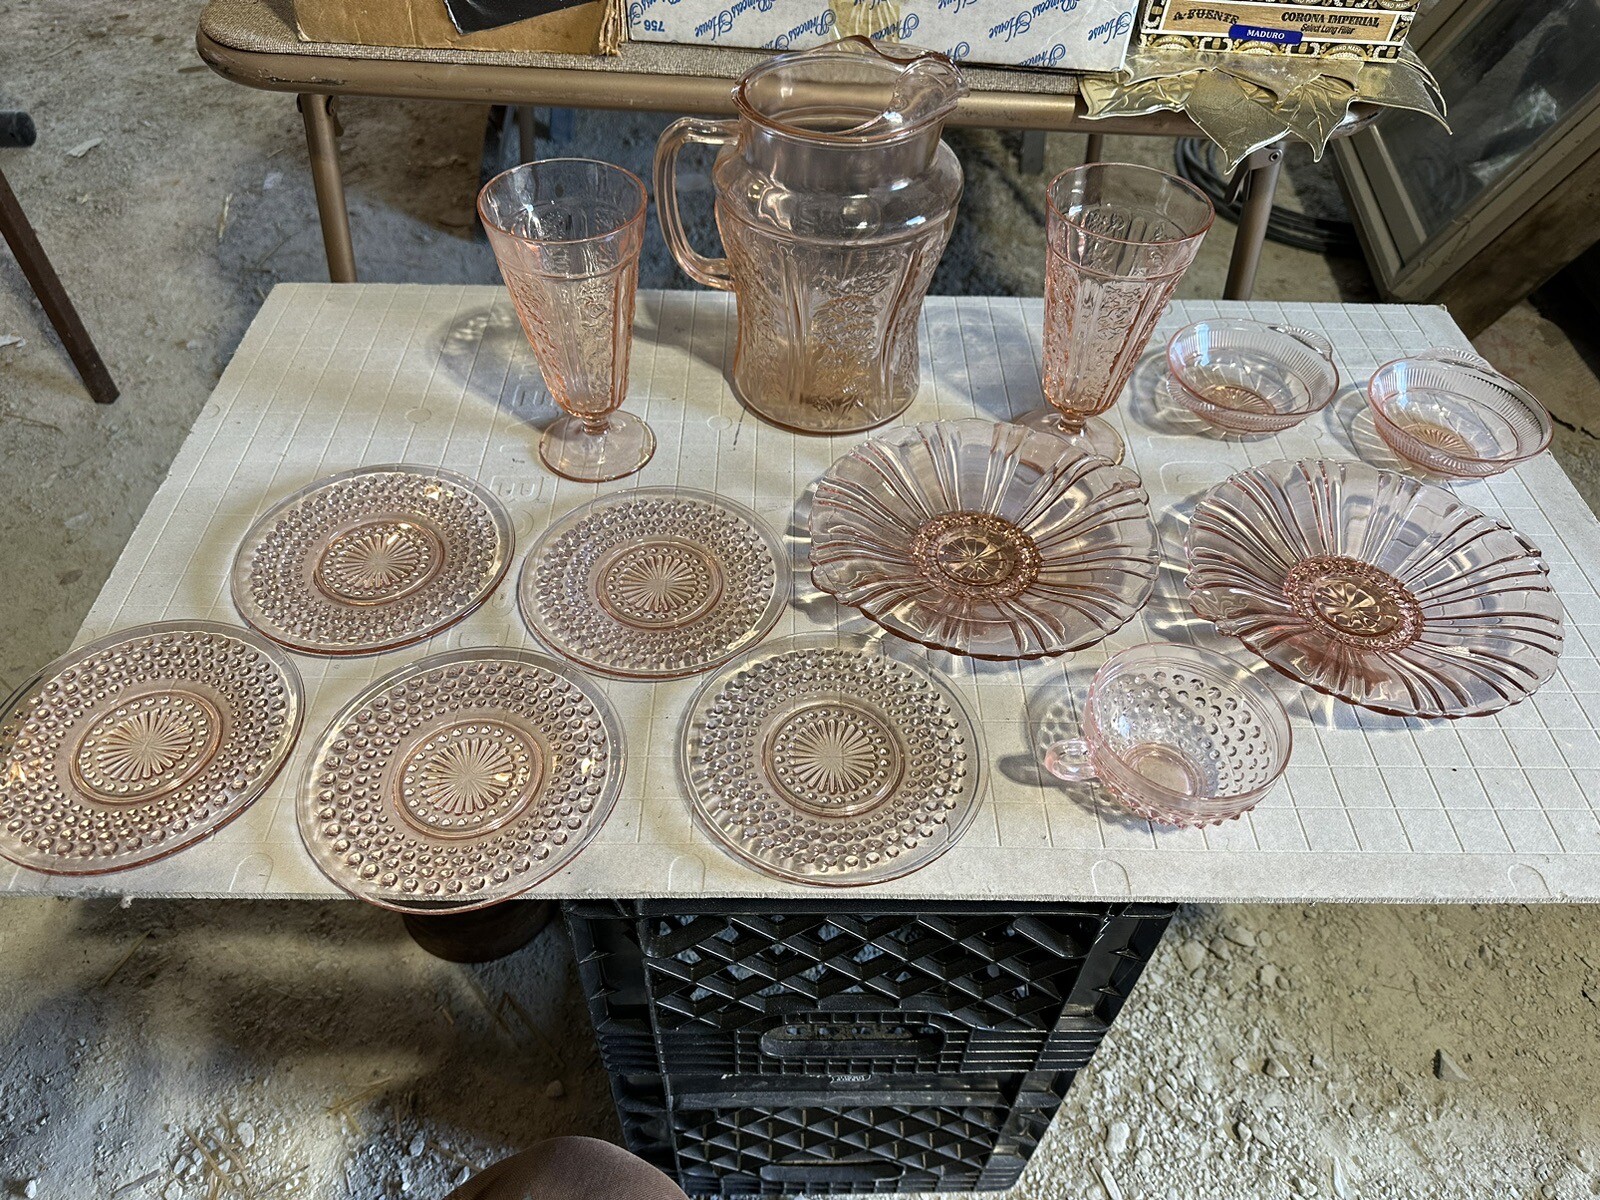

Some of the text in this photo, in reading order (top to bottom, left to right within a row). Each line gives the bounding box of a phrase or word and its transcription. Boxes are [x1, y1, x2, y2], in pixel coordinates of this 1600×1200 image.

[643, 19, 665, 32] 756
[695, 0, 776, 41] Pincess House
[787, 9, 836, 42] Princess
[988, 0, 1080, 43] Pincess House
[1088, 11, 1132, 44] House
[1281, 11, 1380, 28] CORONA IMPERIAL
[1301, 23, 1320, 32] Select
[1321, 25, 1338, 35] Long
[1246, 29, 1285, 40] MADURO
